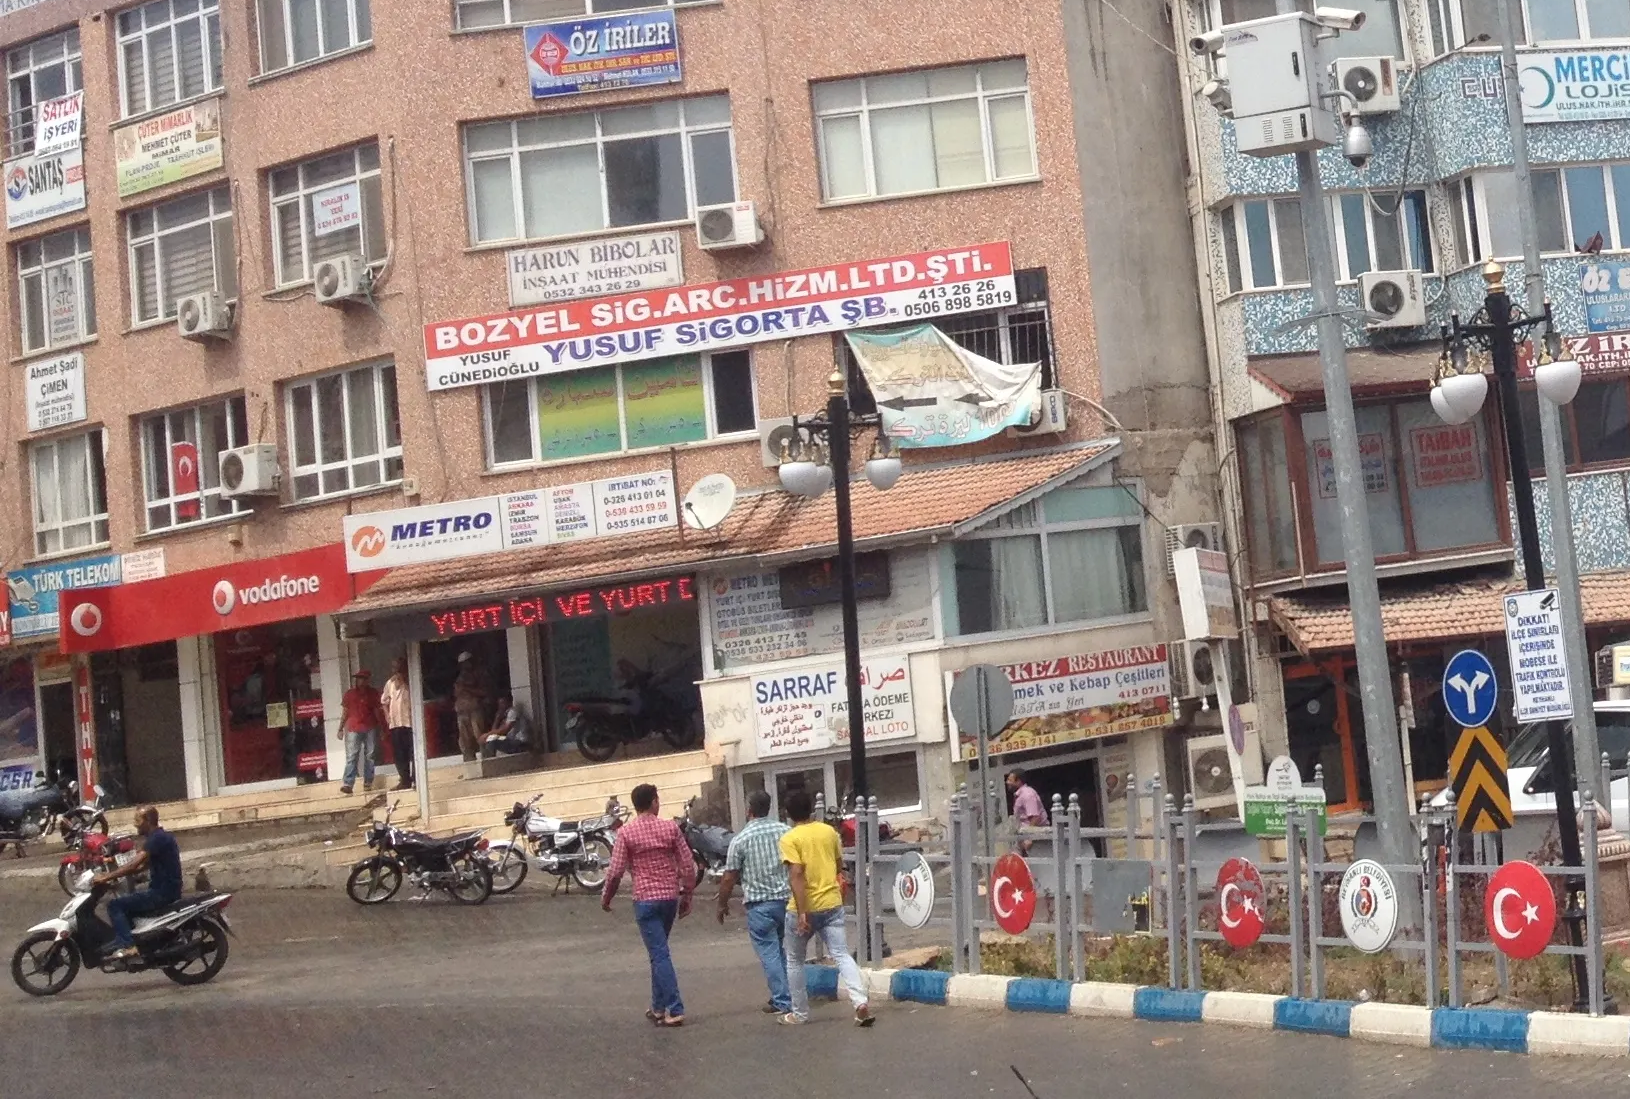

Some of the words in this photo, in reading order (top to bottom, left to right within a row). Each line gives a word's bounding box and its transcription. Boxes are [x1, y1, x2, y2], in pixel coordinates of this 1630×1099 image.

[570, 25, 599, 56] ÖZ
[603, 19, 671, 52] İRİLER
[28, 157, 64, 196] SANTAŞ
[513, 247, 581, 274] HARUN
[590, 236, 675, 264] BİBOLAR
[523, 271, 580, 291] İNŞAAT
[543, 287, 574, 300] 0532
[579, 284, 602, 295] 343
[606, 281, 622, 292] 26
[625, 279, 641, 289] 29
[918, 285, 947, 301] 413
[952, 282, 971, 297] 26
[976, 279, 996, 293] 26
[904, 301, 940, 318] 0506
[945, 295, 972, 312] 898
[976, 290, 1013, 307] 5819
[435, 309, 580, 351] BOZYEL
[543, 327, 663, 365] YUSUF
[841, 295, 899, 327] ŞB.
[30, 361, 57, 380] Ahmet
[460, 349, 511, 367] YUSUF
[627, 493, 642, 502] 413
[629, 504, 643, 514] 433
[390, 512, 492, 542] METRO
[32, 569, 65, 593] TÜRK
[66, 562, 121, 588] TELEKOM
[239, 574, 320, 604] vodafone
[430, 605, 503, 634] YURT
[554, 592, 593, 617] VE
[599, 580, 671, 611] YURT
[754, 635, 774, 645] 413
[777, 633, 791, 642] 77
[1001, 658, 1061, 683] RKEZ
[1068, 645, 1162, 674] RESTAURANT
[756, 671, 837, 705] SARRAF
[1049, 682, 1065, 694] ve
[1069, 674, 1111, 693] Kebap
[1115, 665, 1166, 688] Çeşitleri
[1118, 689, 1140, 699] 413
[1142, 684, 1166, 696] 0711
[882, 721, 909, 735] LOTO
[1006, 740, 1027, 752] 939
[1031, 735, 1057, 748] 7141
